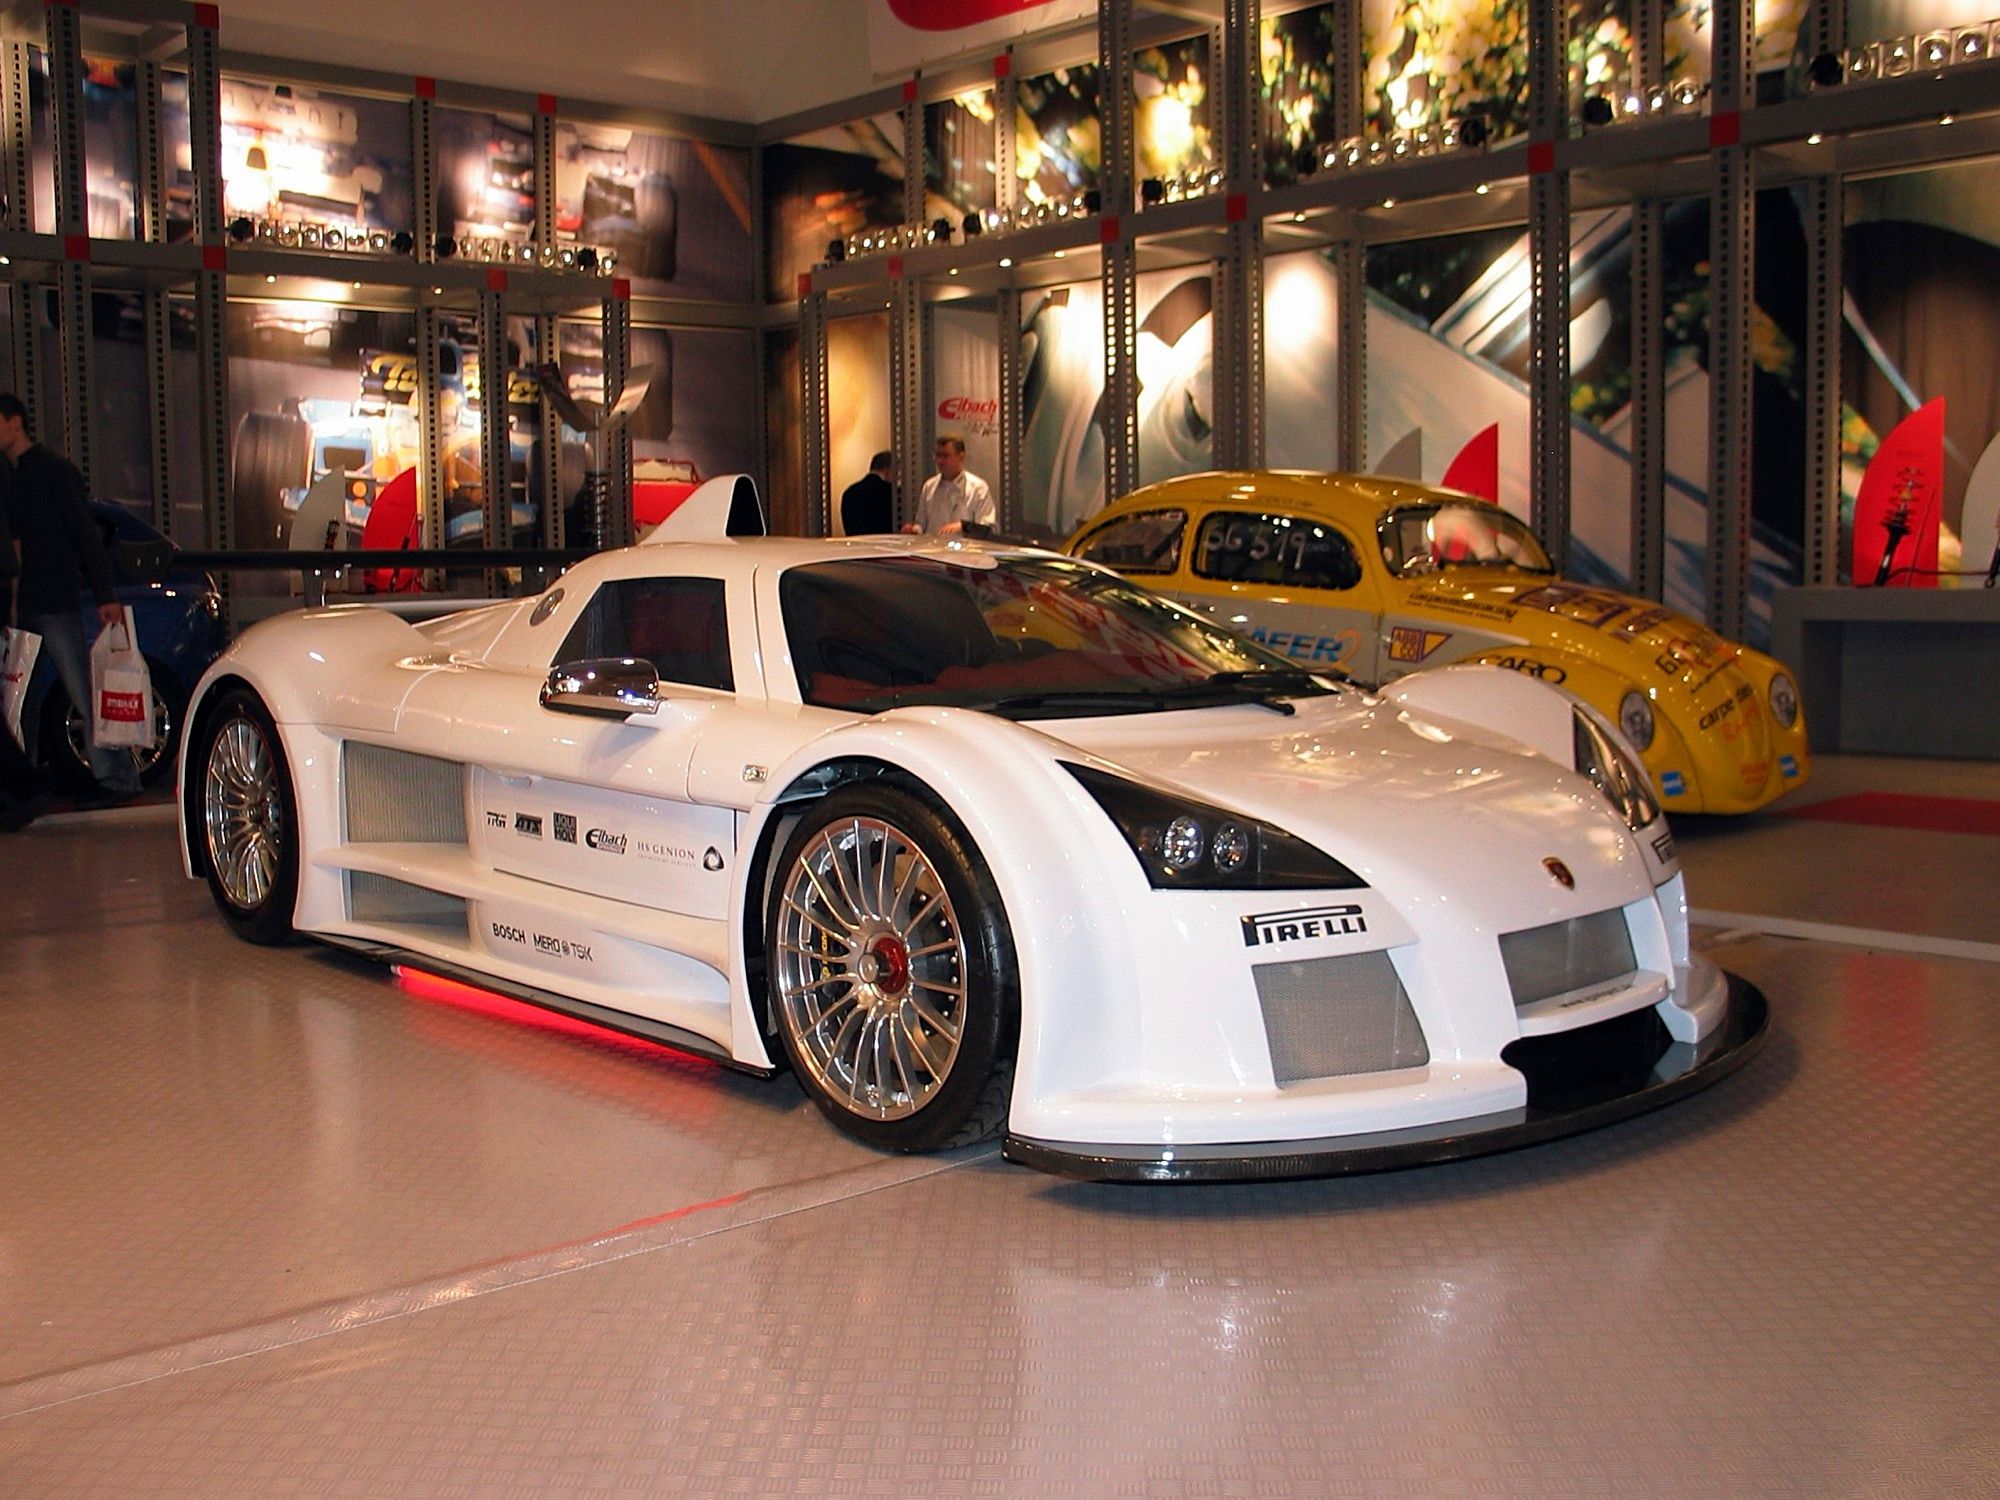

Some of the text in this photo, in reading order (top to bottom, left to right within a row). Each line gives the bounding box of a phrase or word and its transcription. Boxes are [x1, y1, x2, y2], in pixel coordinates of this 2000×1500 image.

[586, 828, 628, 855] Eibach
[652, 845, 695, 860] GENION
[492, 922, 527, 944] BOSCH
[1239, 904, 1368, 947] PIRELLI
[533, 933, 561, 954] MERO
[570, 942, 594, 962] TSK
